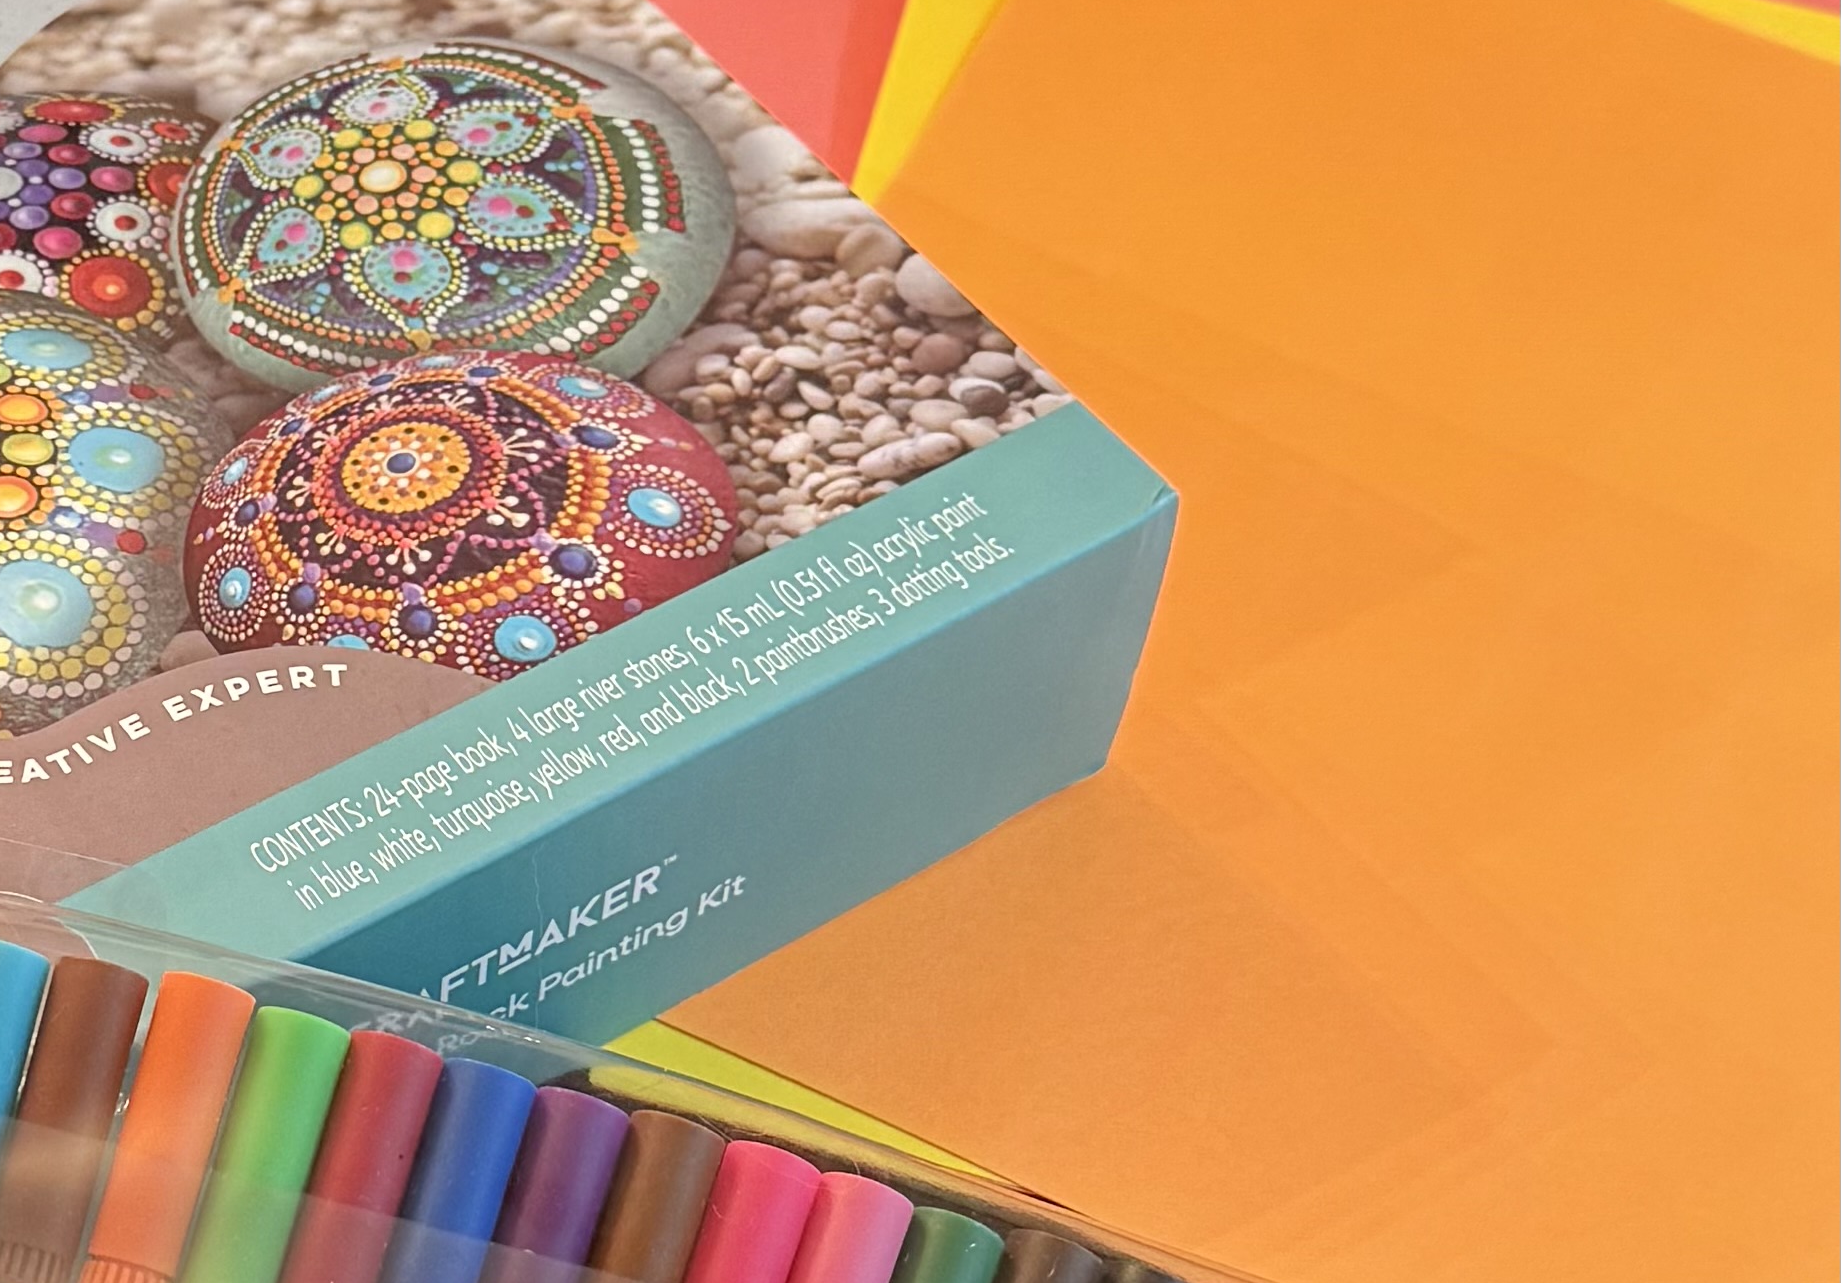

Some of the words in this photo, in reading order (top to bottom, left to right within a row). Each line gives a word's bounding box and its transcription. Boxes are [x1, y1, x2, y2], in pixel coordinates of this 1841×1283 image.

[930, 492, 989, 538] paint
[843, 540, 884, 579] oz)
[872, 516, 939, 566] acrylic
[744, 593, 786, 627] mL
[769, 568, 829, 618] (0.51
[686, 625, 712, 655] 6
[716, 605, 750, 639] 15
[623, 641, 699, 689] stones,
[161, 662, 350, 723] EXPERT
[518, 692, 585, 738] large
[577, 672, 632, 713] river
[286, 879, 325, 911] in
[311, 857, 380, 899] blue,
[369, 825, 443, 872] white,
[429, 778, 541, 841] turquoise,
[528, 739, 609, 800] yellow,
[603, 715, 649, 758] red,
[639, 691, 687, 736] and
[679, 667, 748, 715] black,
[732, 657, 761, 686] 2
[753, 601, 886, 686] paintbrushes,
[867, 587, 897, 617] 3
[889, 552, 970, 609] dotting
[958, 531, 1016, 576] tools.
[506, 716, 532, 744] 4
[444, 727, 519, 775] book,
[362, 759, 459, 818] 24-page
[250, 794, 374, 873] CONTENTS:
[537, 904, 689, 1002] Painting
[696, 873, 748, 917] Kit
